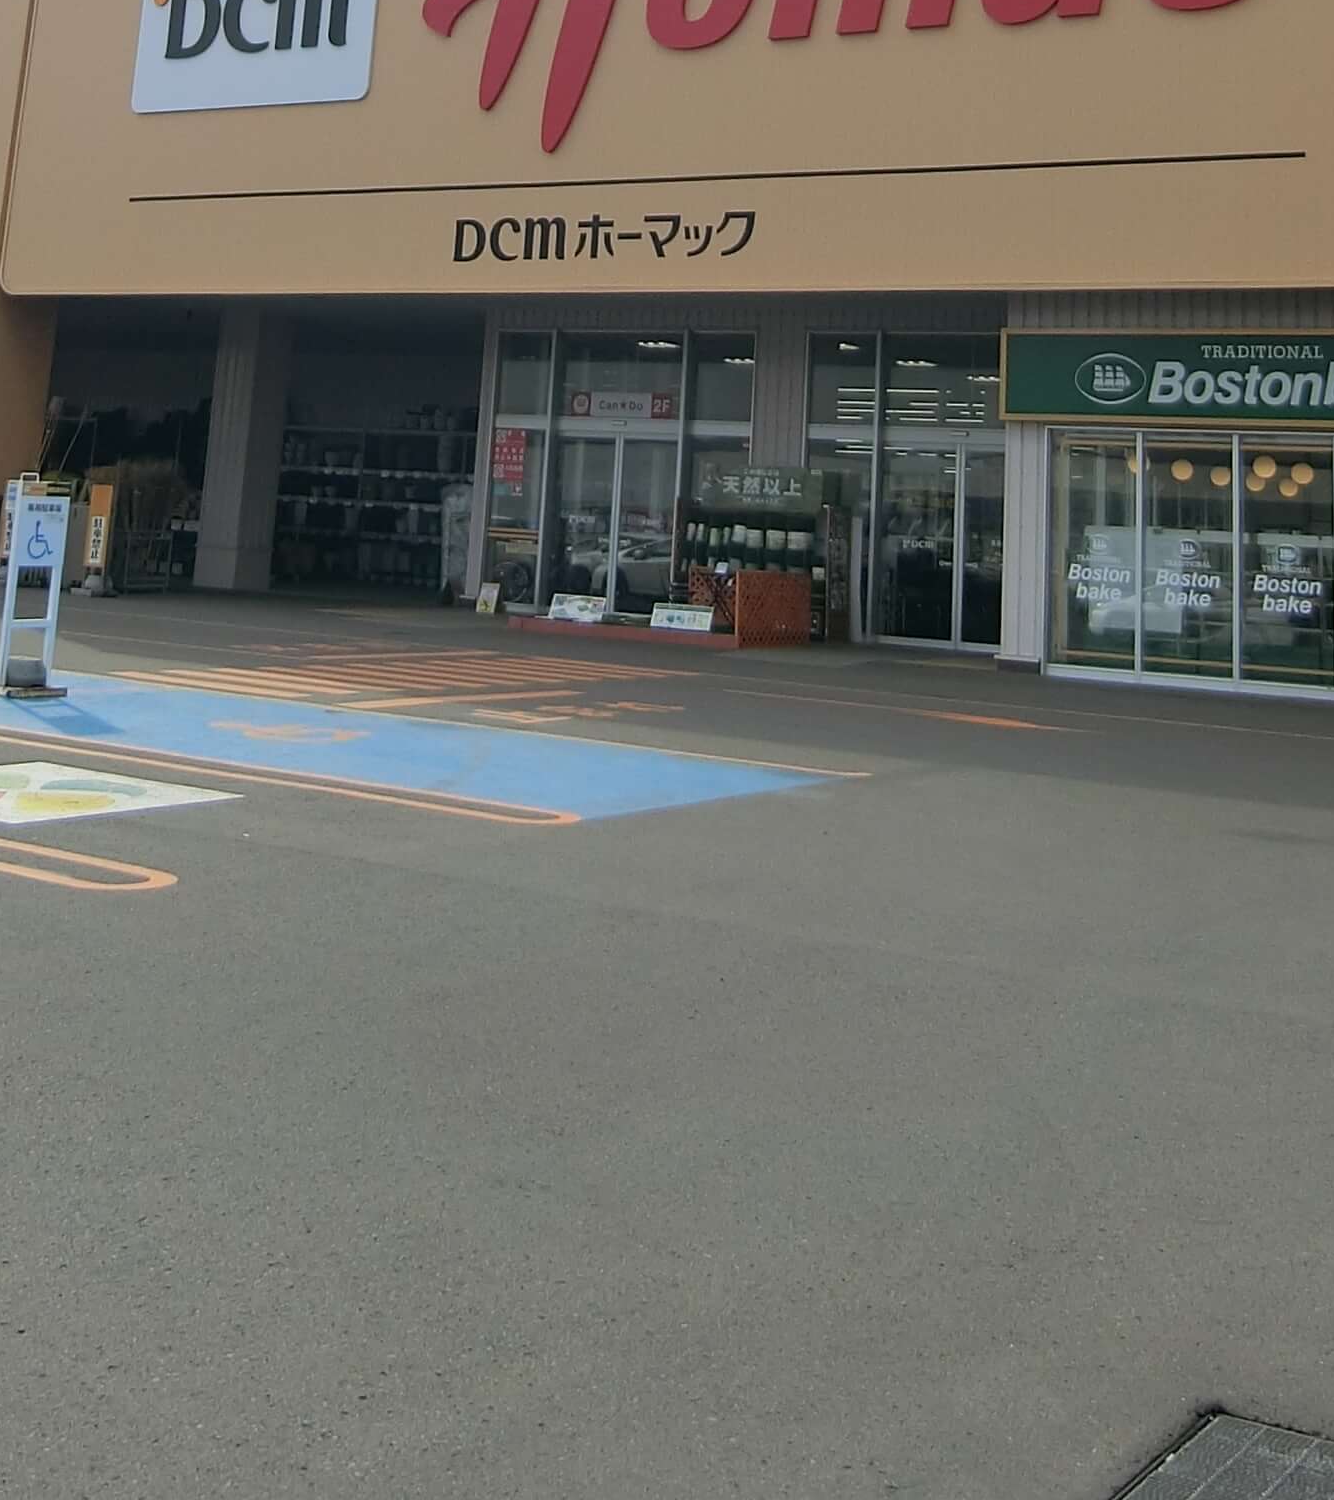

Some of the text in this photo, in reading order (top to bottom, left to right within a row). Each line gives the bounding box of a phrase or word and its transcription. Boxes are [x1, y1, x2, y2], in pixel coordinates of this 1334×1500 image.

[1201, 344, 1325, 359] TRADITIONAL
[653, 399, 672, 413] 2F
[722, 475, 803, 496] 天然以上
[1068, 563, 1131, 584] Boston
[1156, 569, 1222, 590] Boston
[1076, 583, 1122, 601] bake
[1253, 574, 1323, 596] Boston
[1164, 589, 1212, 608] bake
[1262, 595, 1313, 615] bake
